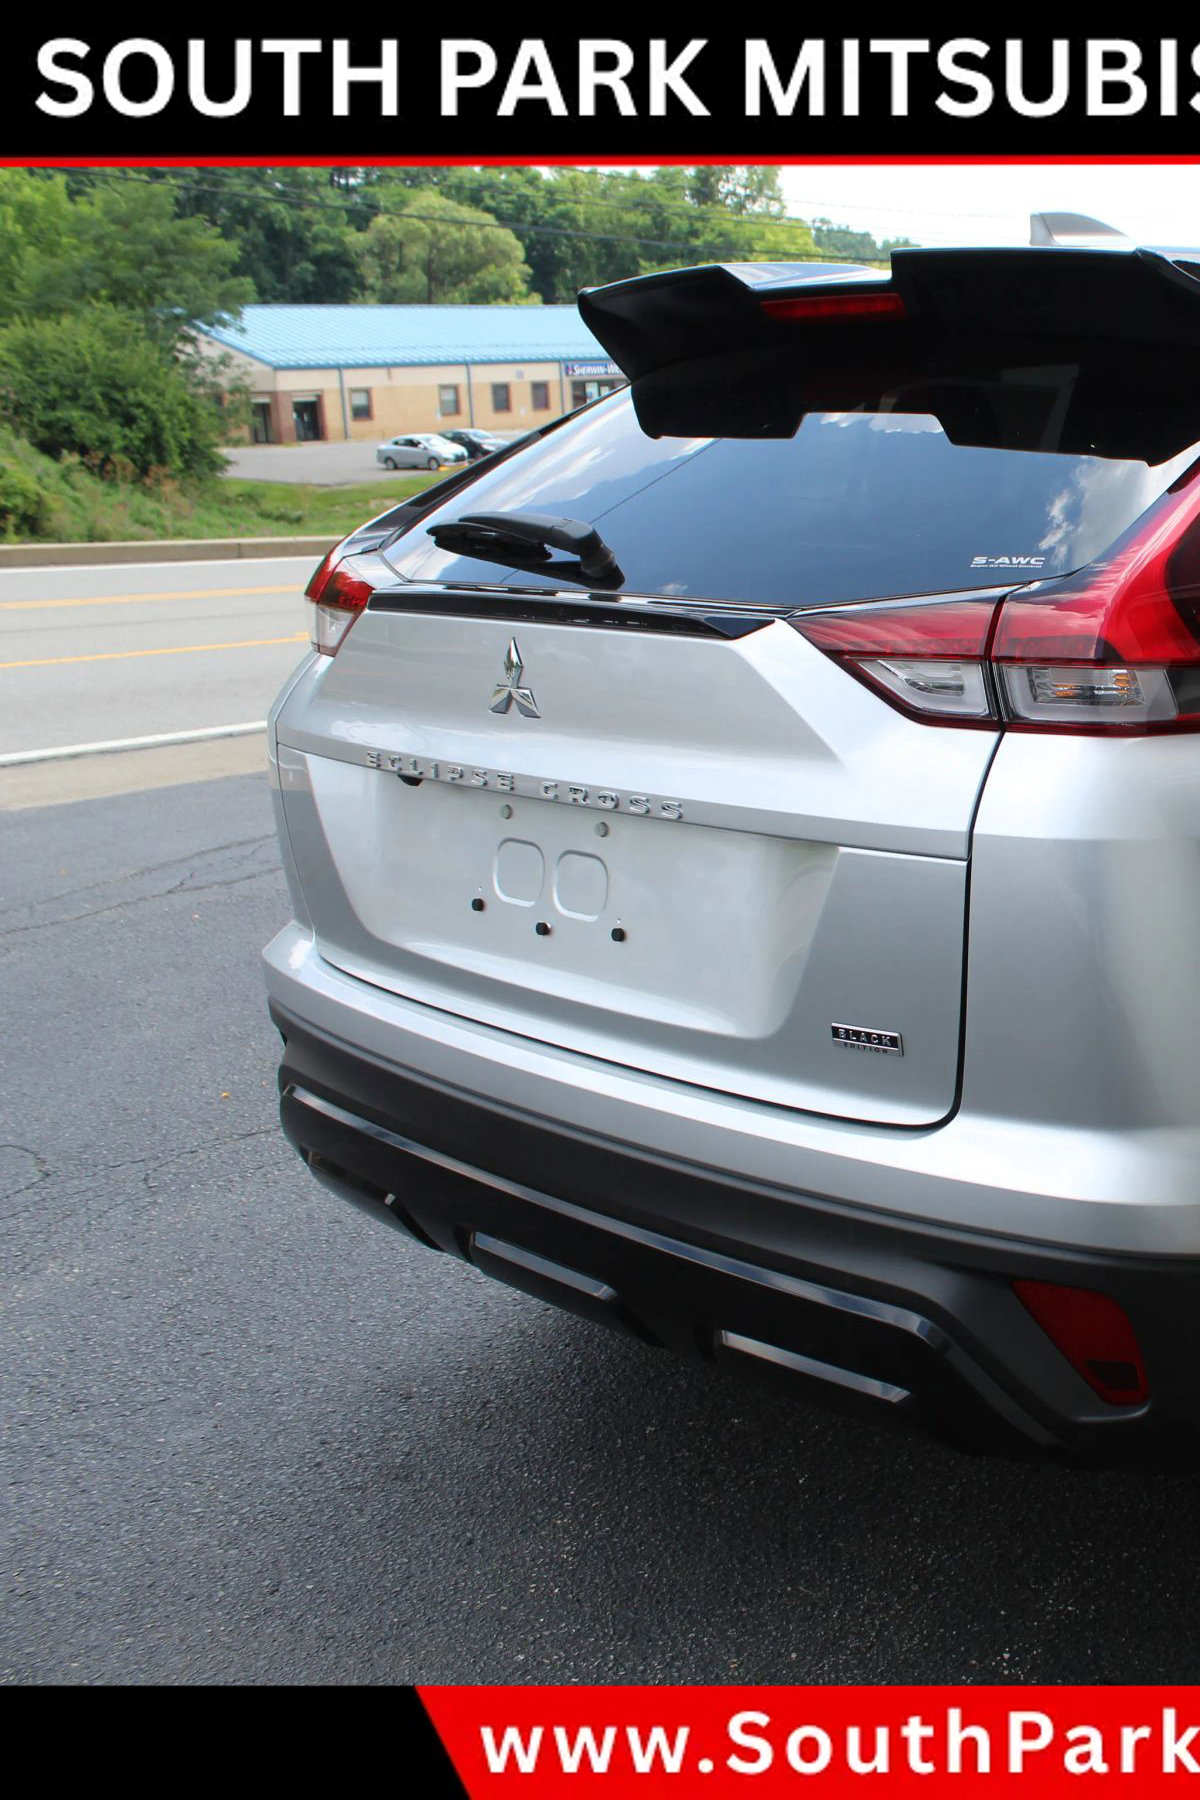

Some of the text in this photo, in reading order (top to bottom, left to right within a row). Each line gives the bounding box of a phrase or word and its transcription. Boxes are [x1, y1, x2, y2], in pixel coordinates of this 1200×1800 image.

[972, 556, 1046, 565] S-AWC
[367, 750, 684, 820] ECLIPSE CROSS
[838, 1028, 892, 1046] BLACK
[844, 1042, 888, 1055] EDITION
